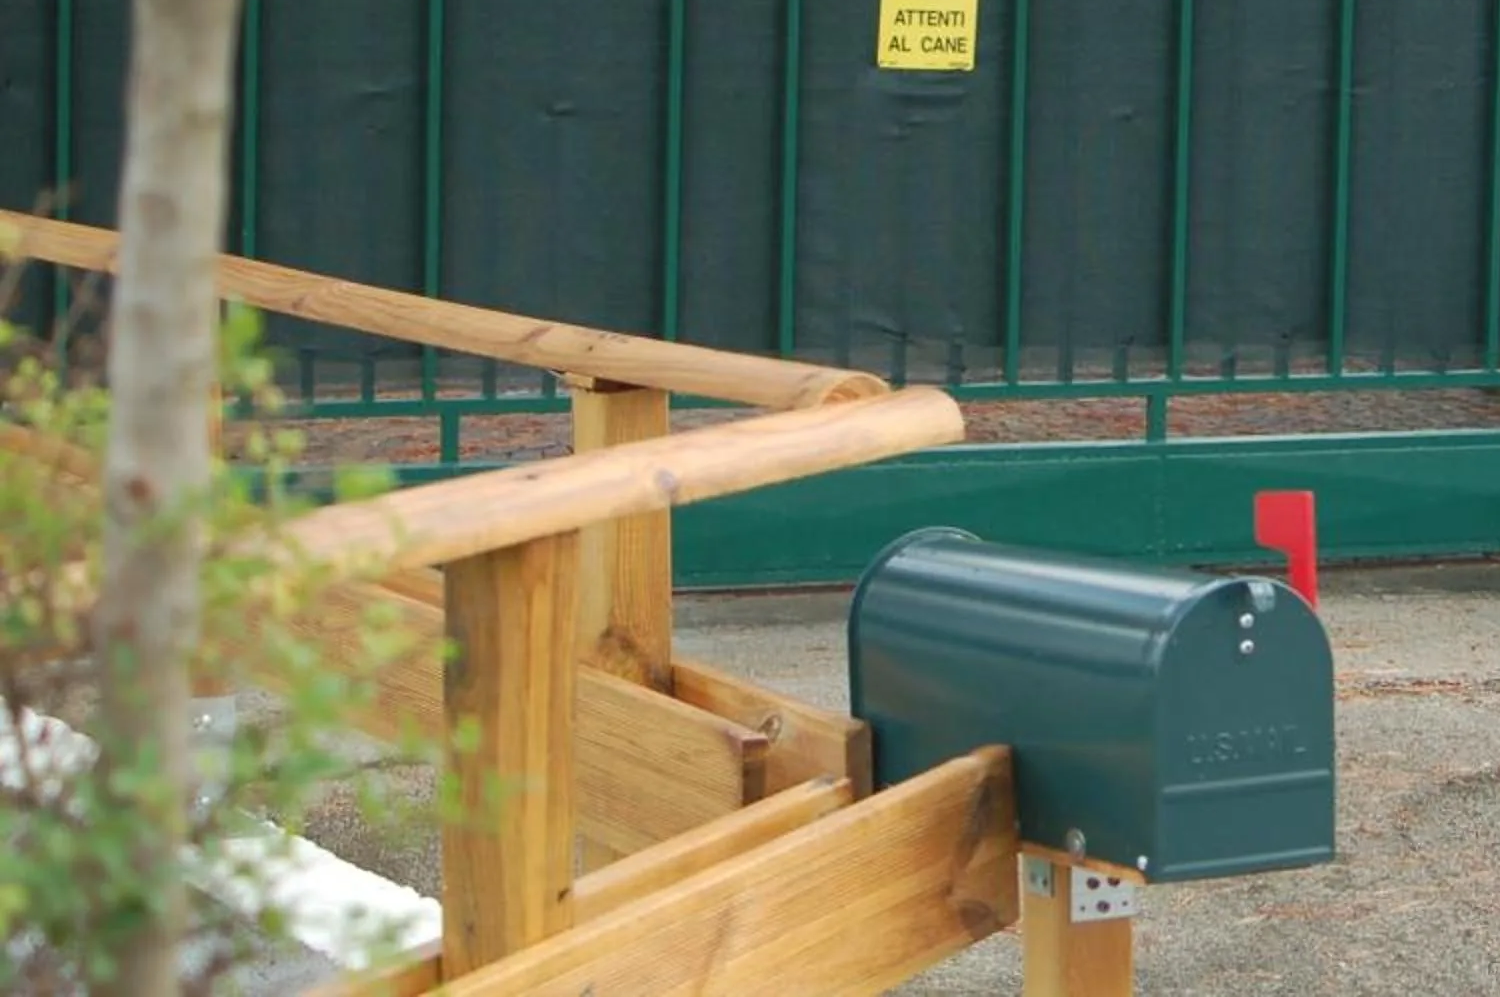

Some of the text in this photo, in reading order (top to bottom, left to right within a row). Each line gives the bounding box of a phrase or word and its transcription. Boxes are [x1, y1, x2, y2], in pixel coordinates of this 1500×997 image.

[894, 9, 966, 27] ATTENTI
[888, 36, 968, 53] AL CANE
